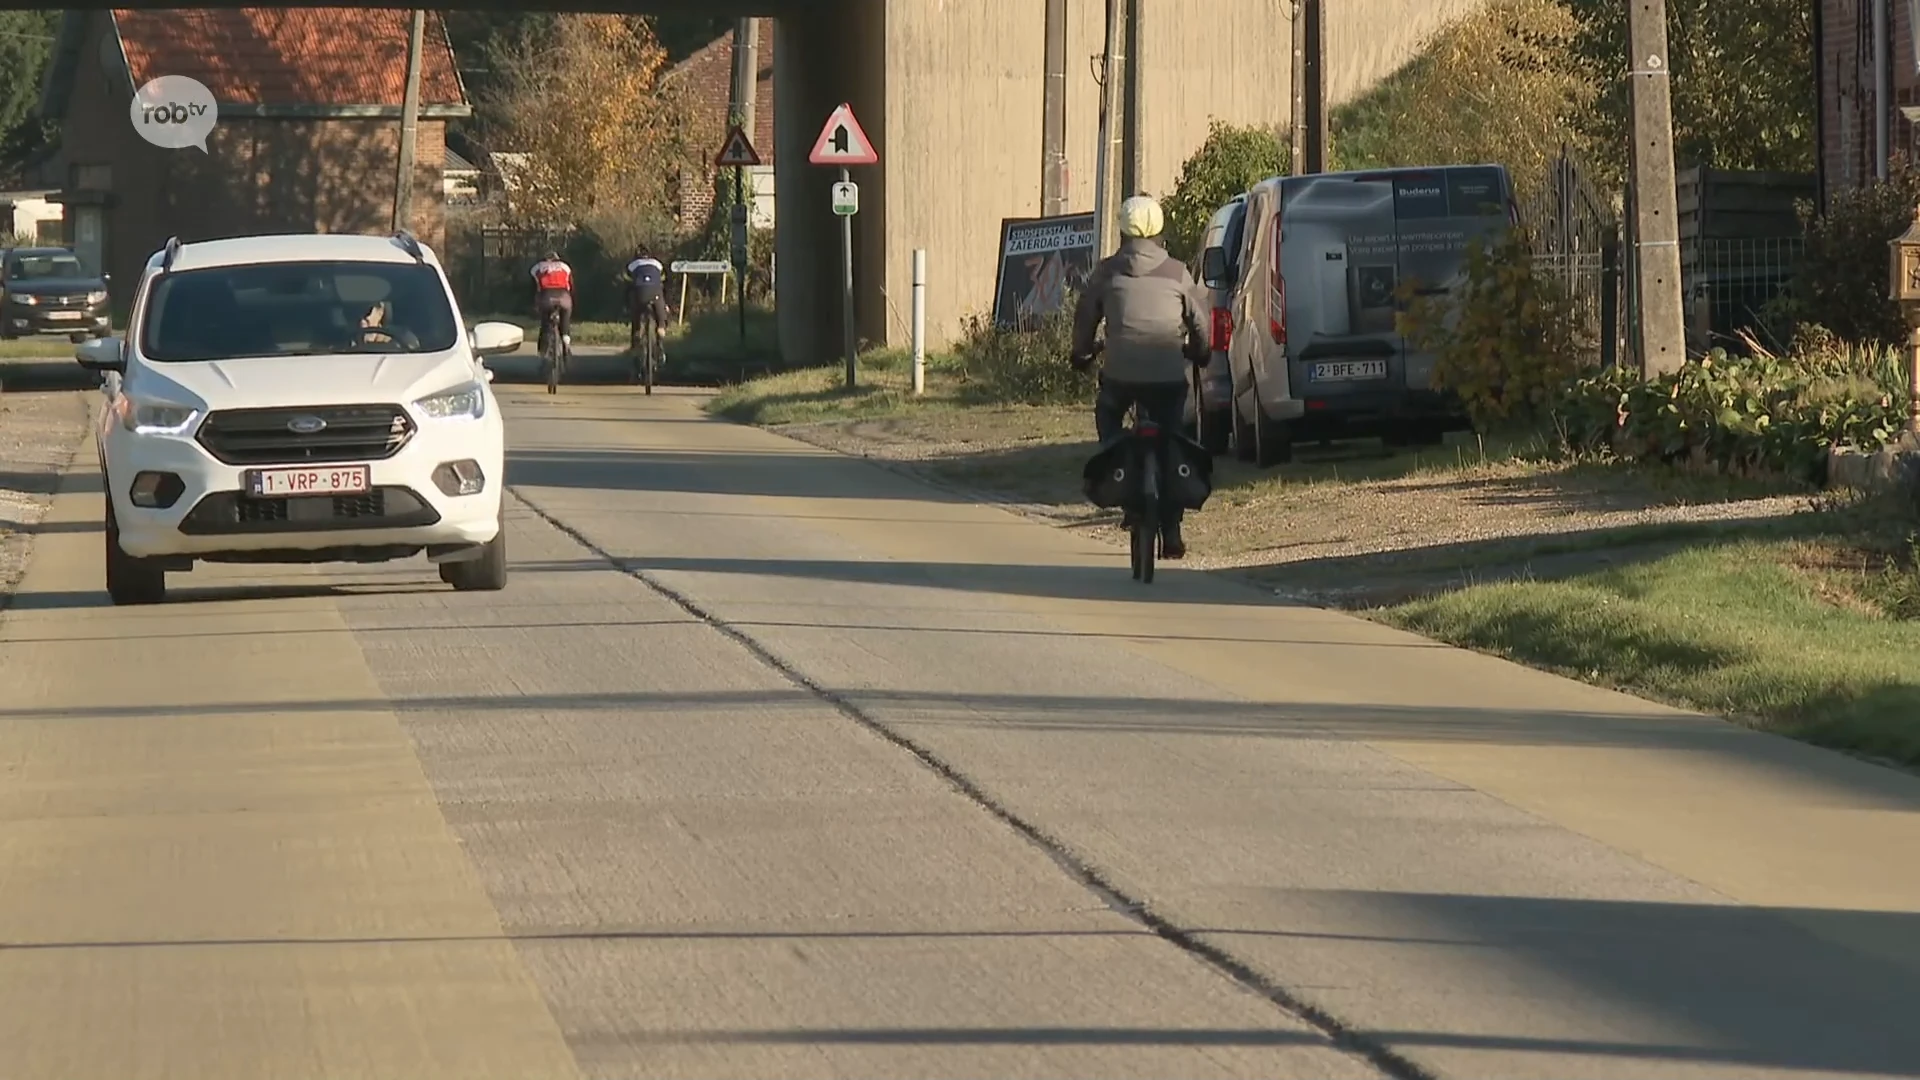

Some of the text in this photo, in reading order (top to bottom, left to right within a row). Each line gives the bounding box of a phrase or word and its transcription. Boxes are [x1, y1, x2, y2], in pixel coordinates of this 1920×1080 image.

[1399, 187, 1440, 196] Buderus
[1010, 236, 1059, 251] ZATERDAG
[1063, 234, 1074, 246] 15
